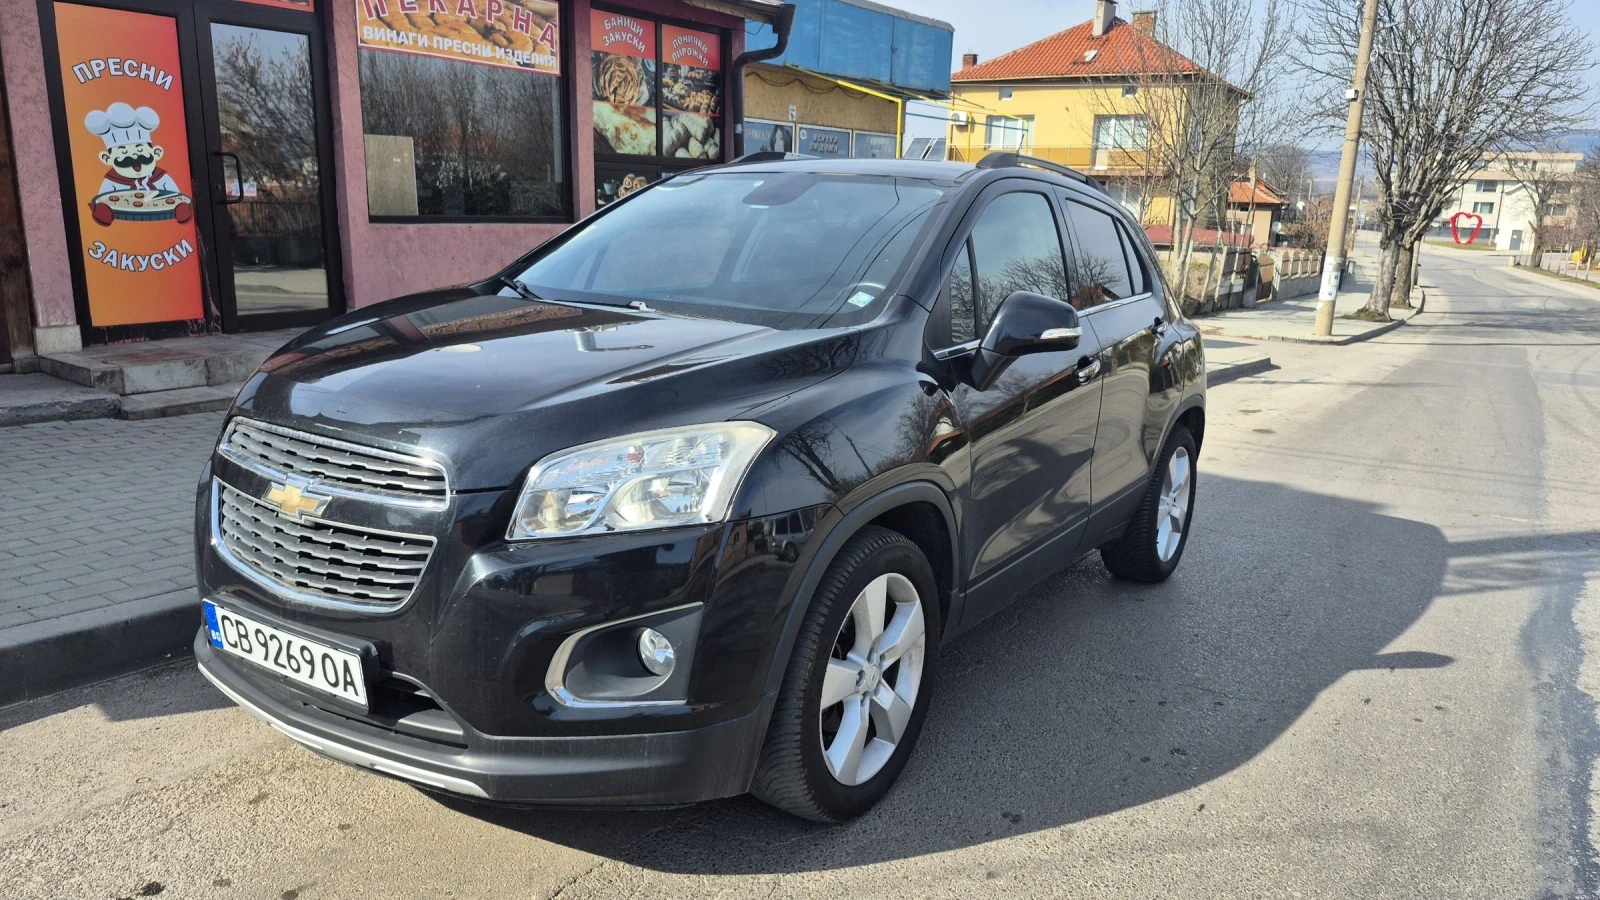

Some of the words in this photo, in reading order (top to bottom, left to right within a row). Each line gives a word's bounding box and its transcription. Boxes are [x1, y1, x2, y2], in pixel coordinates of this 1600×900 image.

[604, 16, 644, 36] БАНИЦИ
[363, 25, 429, 48] ВИНАГИ
[433, 37, 492, 58] ПРЕСНИ
[495, 46, 557, 67] ИЗДЕЛИЯ
[602, 31, 646, 53] ЗАКУСКИ
[672, 35, 708, 54] ПОНИЧКИ
[671, 47, 709, 67] ПИРОЖКИ
[72, 57, 174, 91] ПРЕСНИ
[87, 238, 194, 272] ЗАКУСКИ
[210, 629, 222, 642] BG
[221, 614, 252, 655] CB
[254, 627, 315, 680] 9269
[321, 652, 359, 697] OA
